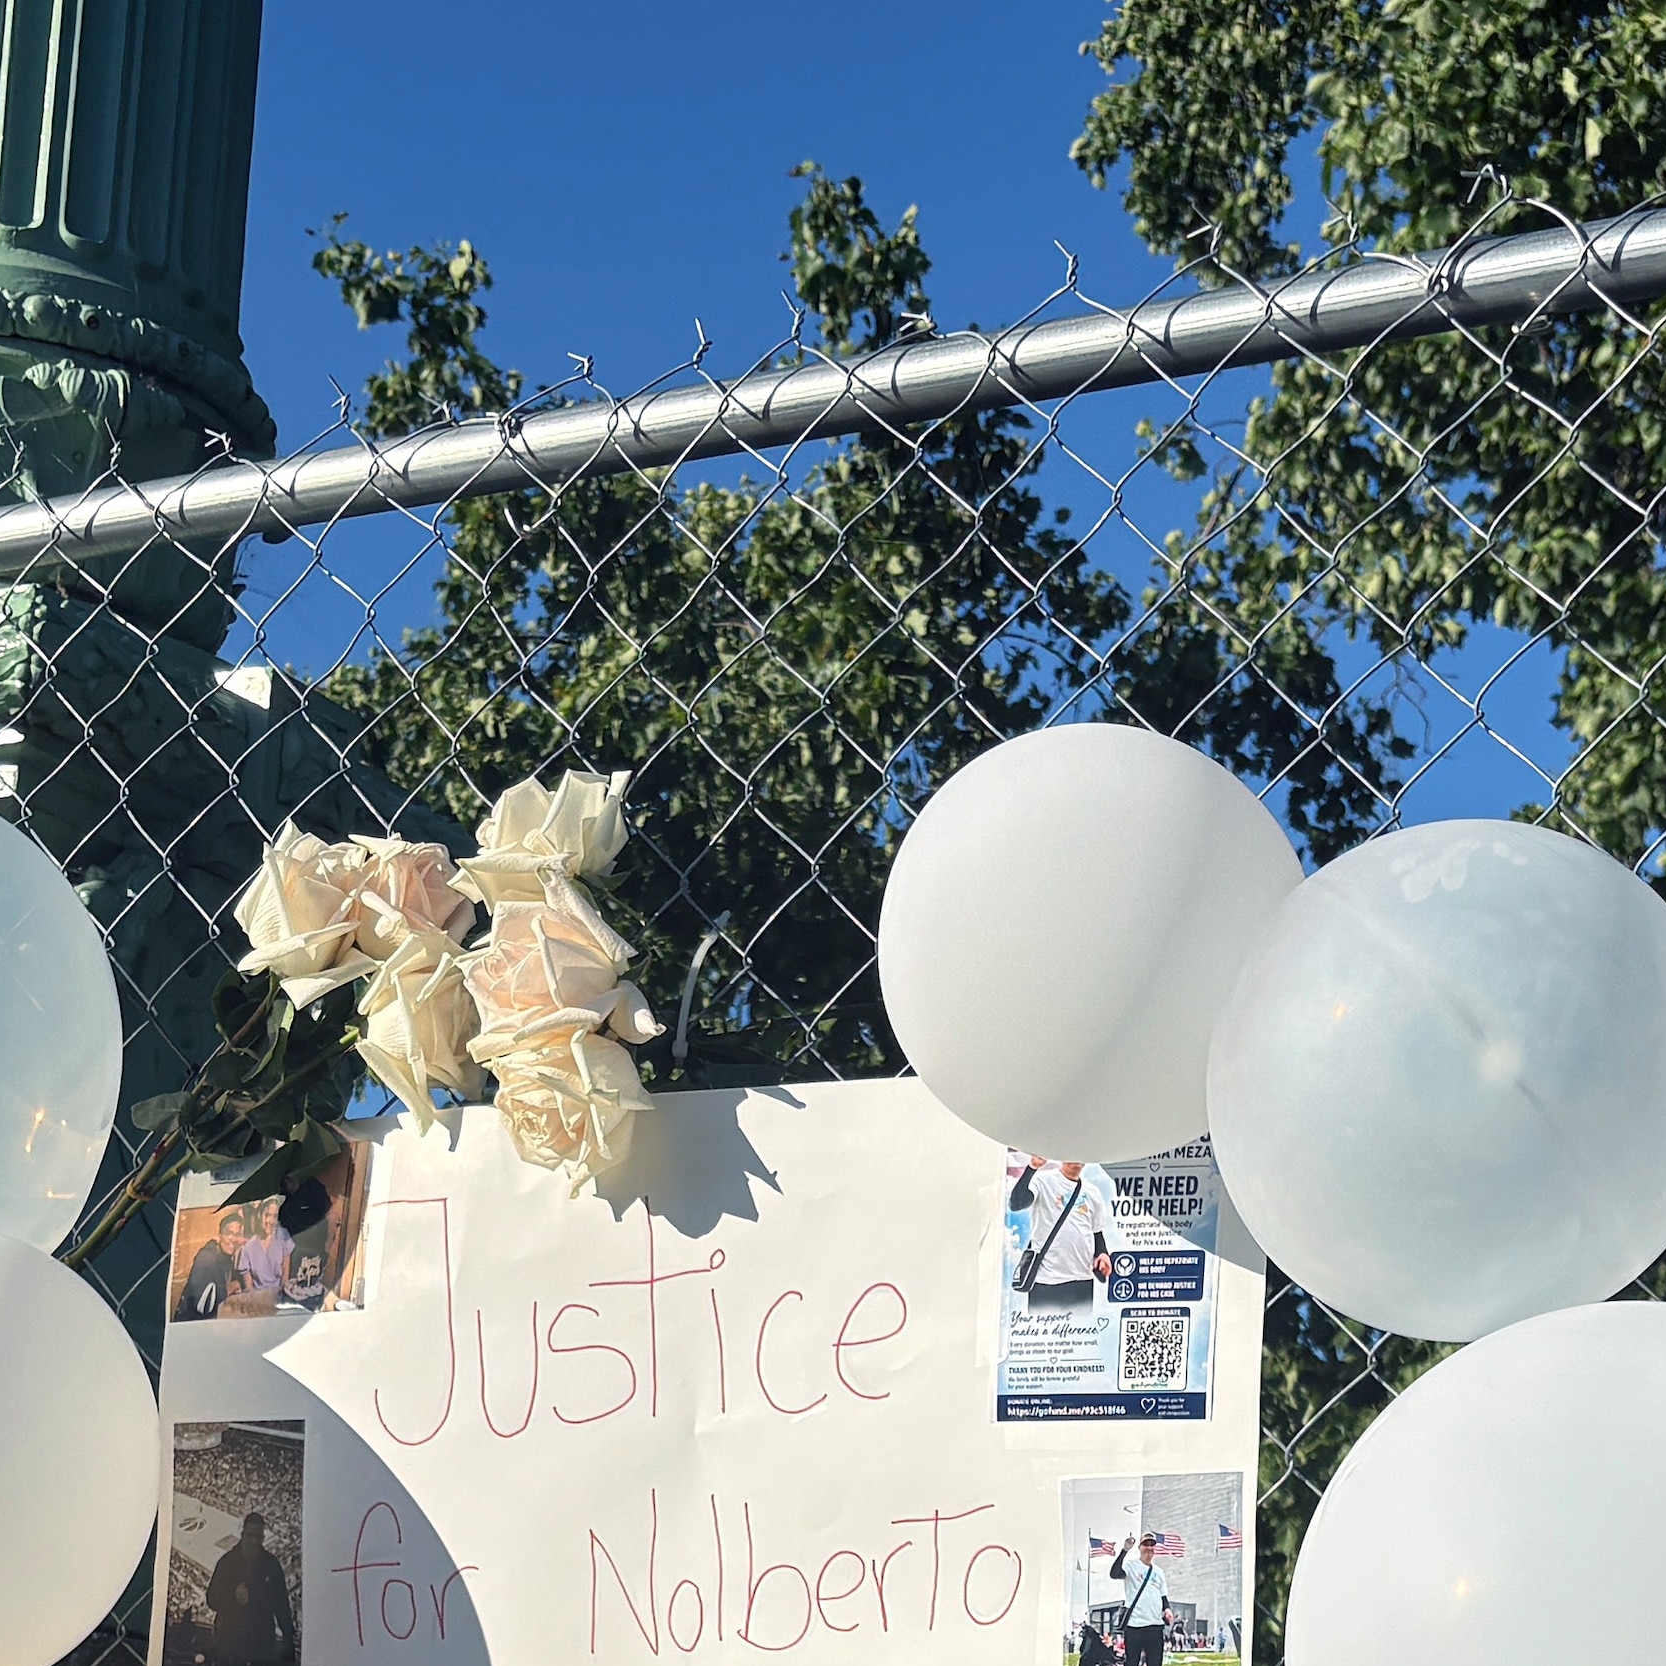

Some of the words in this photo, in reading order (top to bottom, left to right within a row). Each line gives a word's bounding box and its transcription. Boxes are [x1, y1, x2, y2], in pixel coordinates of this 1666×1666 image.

[1174, 1146, 1212, 1159] MEZA
[1114, 1177, 1144, 1197] WE
[1149, 1176, 1199, 1197] NEED
[1111, 1199, 1153, 1217] YOUR
[1158, 1198, 1203, 1216] HELP!
[1175, 1220, 1193, 1229] body
[1158, 1229, 1182, 1238] justice
[1139, 1257, 1155, 1265] HELP
[372, 1194, 907, 1446] Justice
[1010, 1310, 1034, 1328] Your
[1036, 1311, 1073, 1326] support
[1011, 1325, 1039, 1337] makes
[331, 1501, 479, 1647] for
